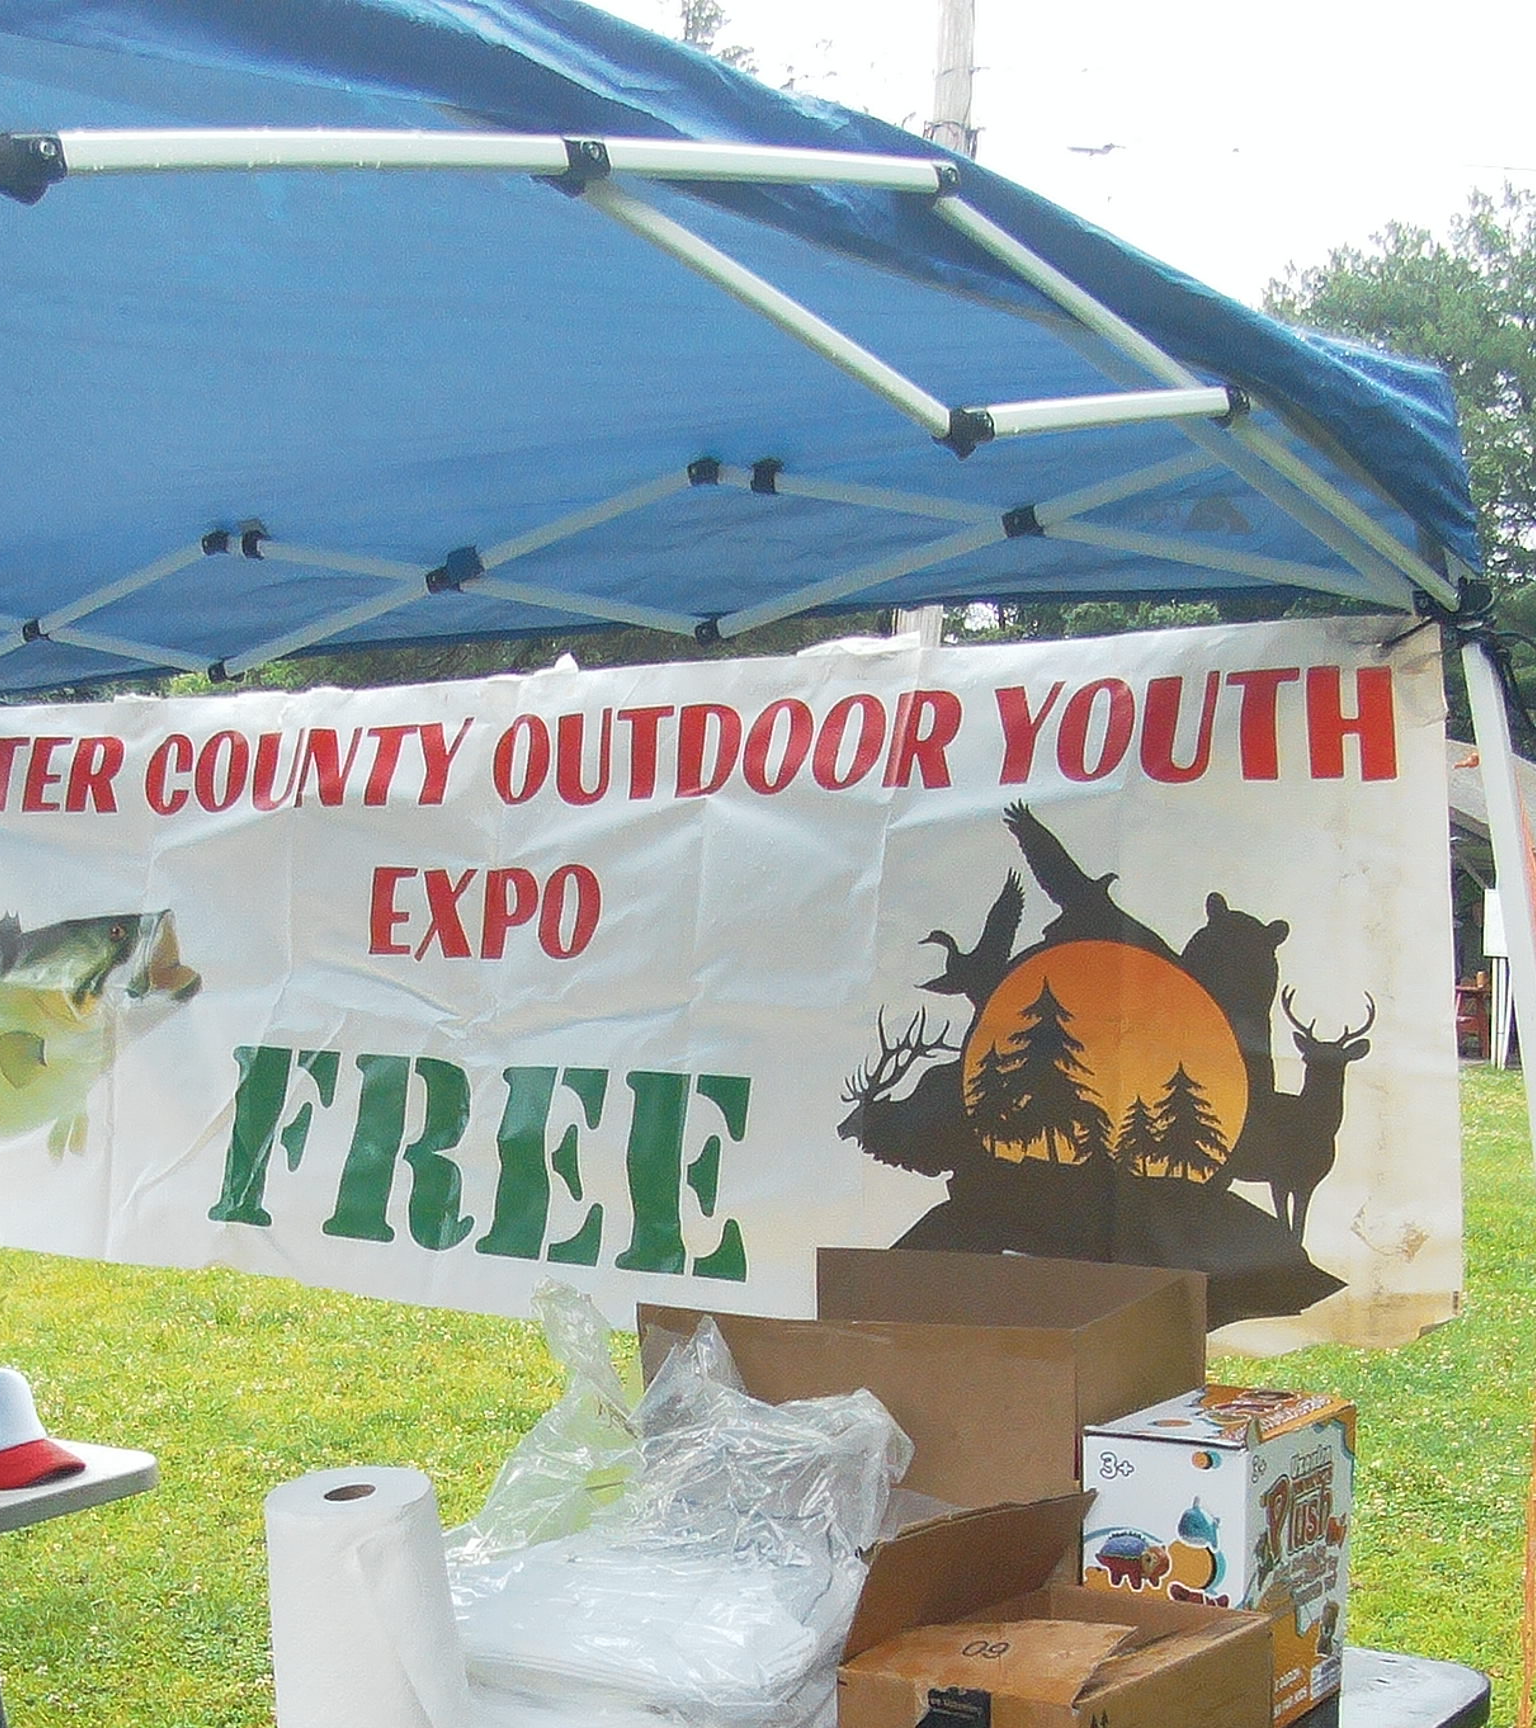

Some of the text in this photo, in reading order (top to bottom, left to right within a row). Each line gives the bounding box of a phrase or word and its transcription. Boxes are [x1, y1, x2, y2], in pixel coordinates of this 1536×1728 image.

[146, 716, 475, 814] COUNTY
[494, 685, 963, 806] OUTDOOR
[997, 665, 1399, 784] YOUTH
[368, 863, 602, 961] EXPO
[207, 1044, 751, 1284] FREE
[1099, 1450, 1135, 1480] 3+
